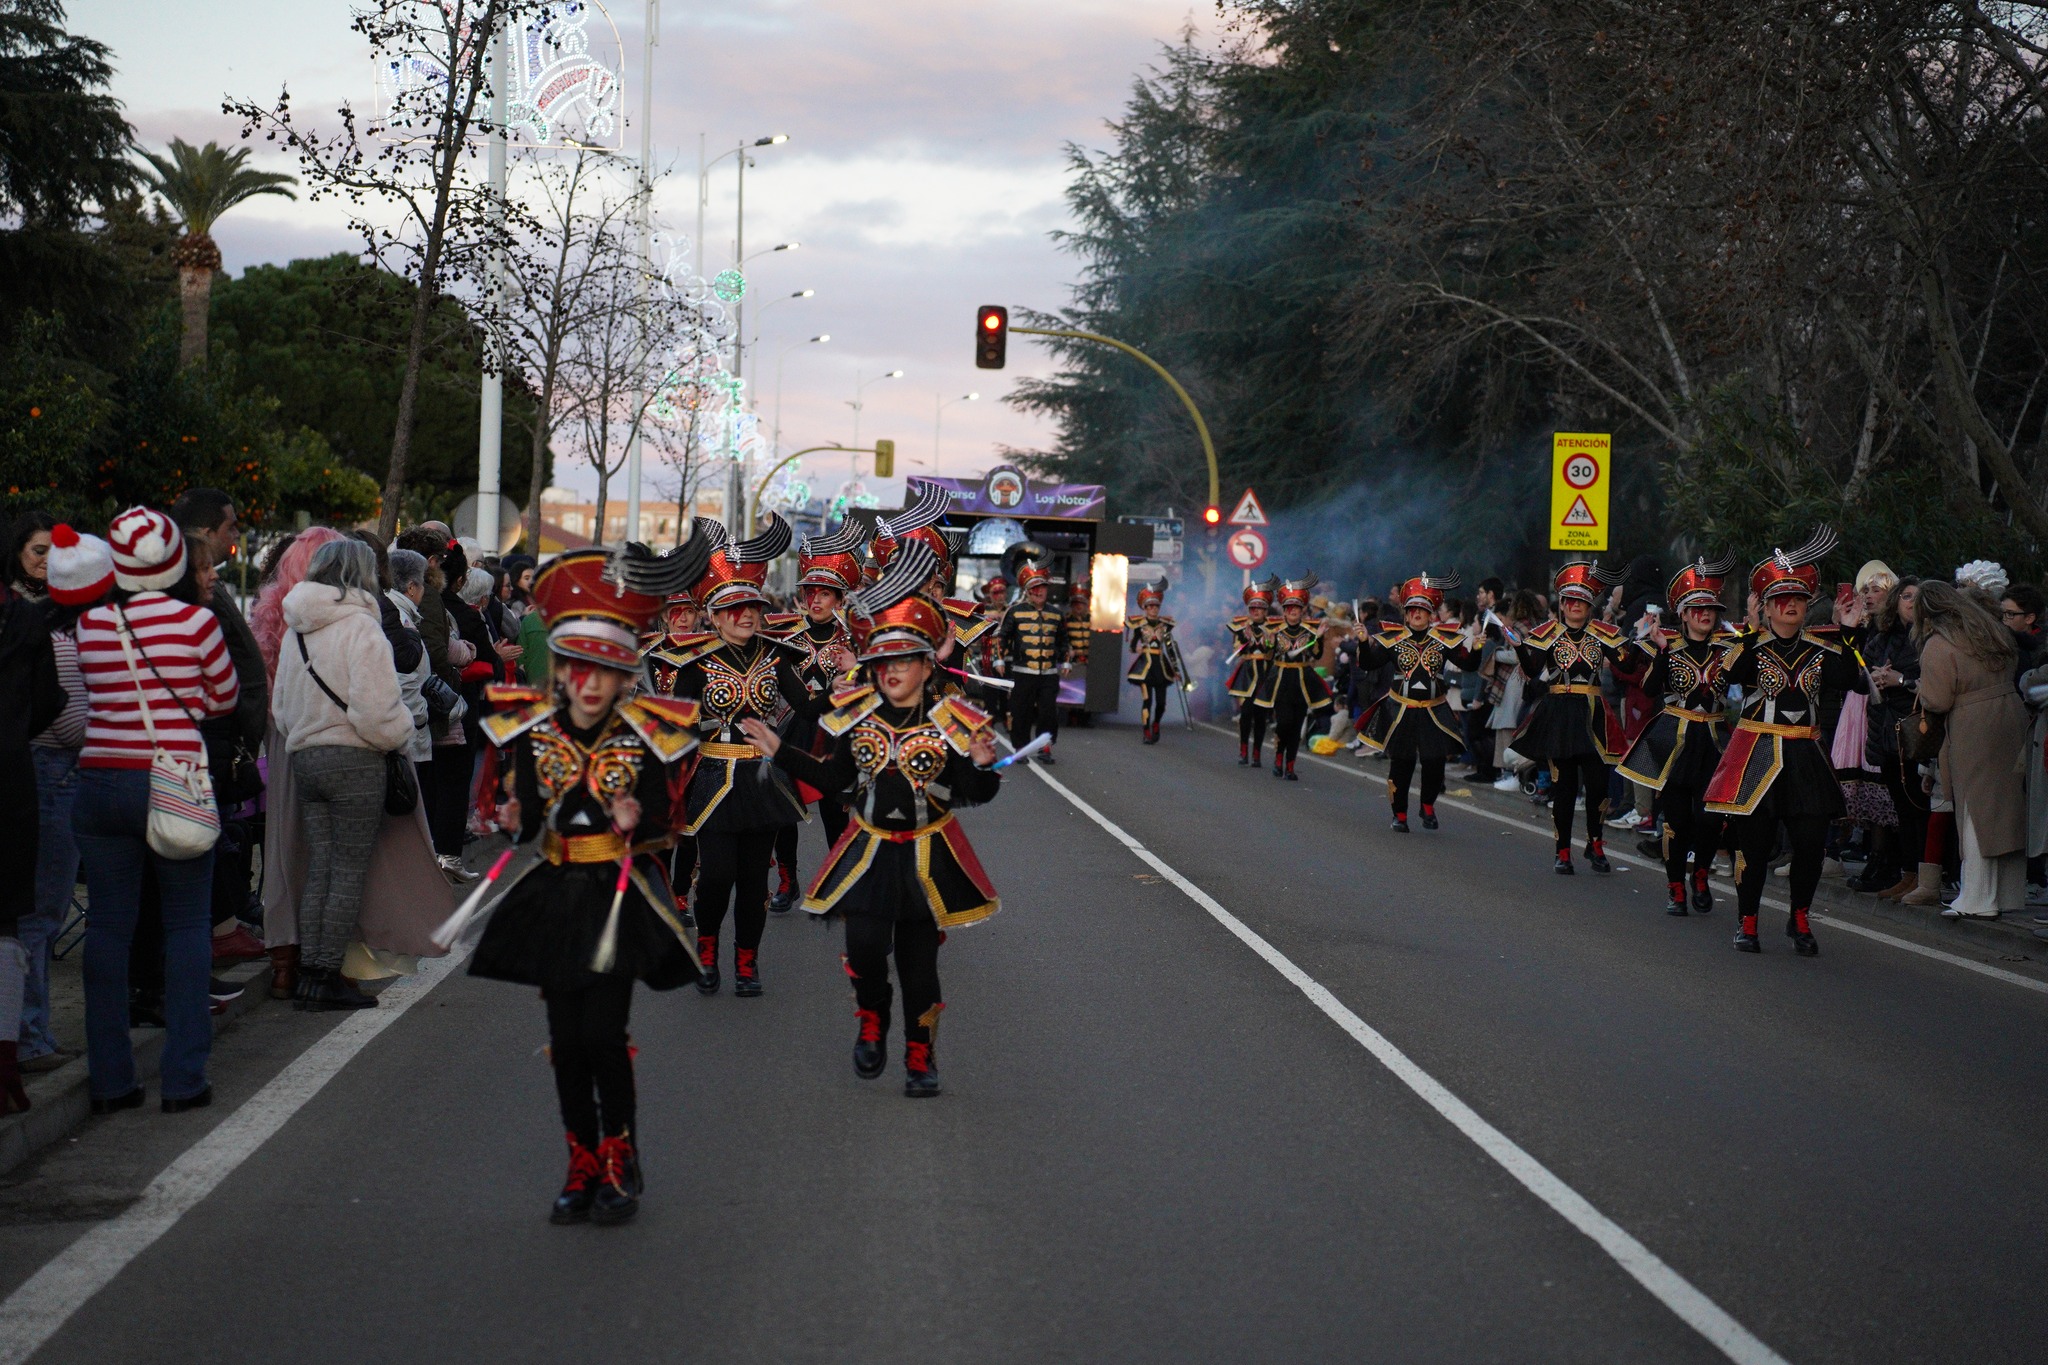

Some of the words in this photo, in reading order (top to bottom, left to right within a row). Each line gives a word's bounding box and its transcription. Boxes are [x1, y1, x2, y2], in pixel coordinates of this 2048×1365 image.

[1557, 438, 1608, 448] ATENCIÓN
[1571, 466, 1592, 477] 30
[1035, 493, 1055, 504] Los
[1057, 494, 1092, 506] Notas
